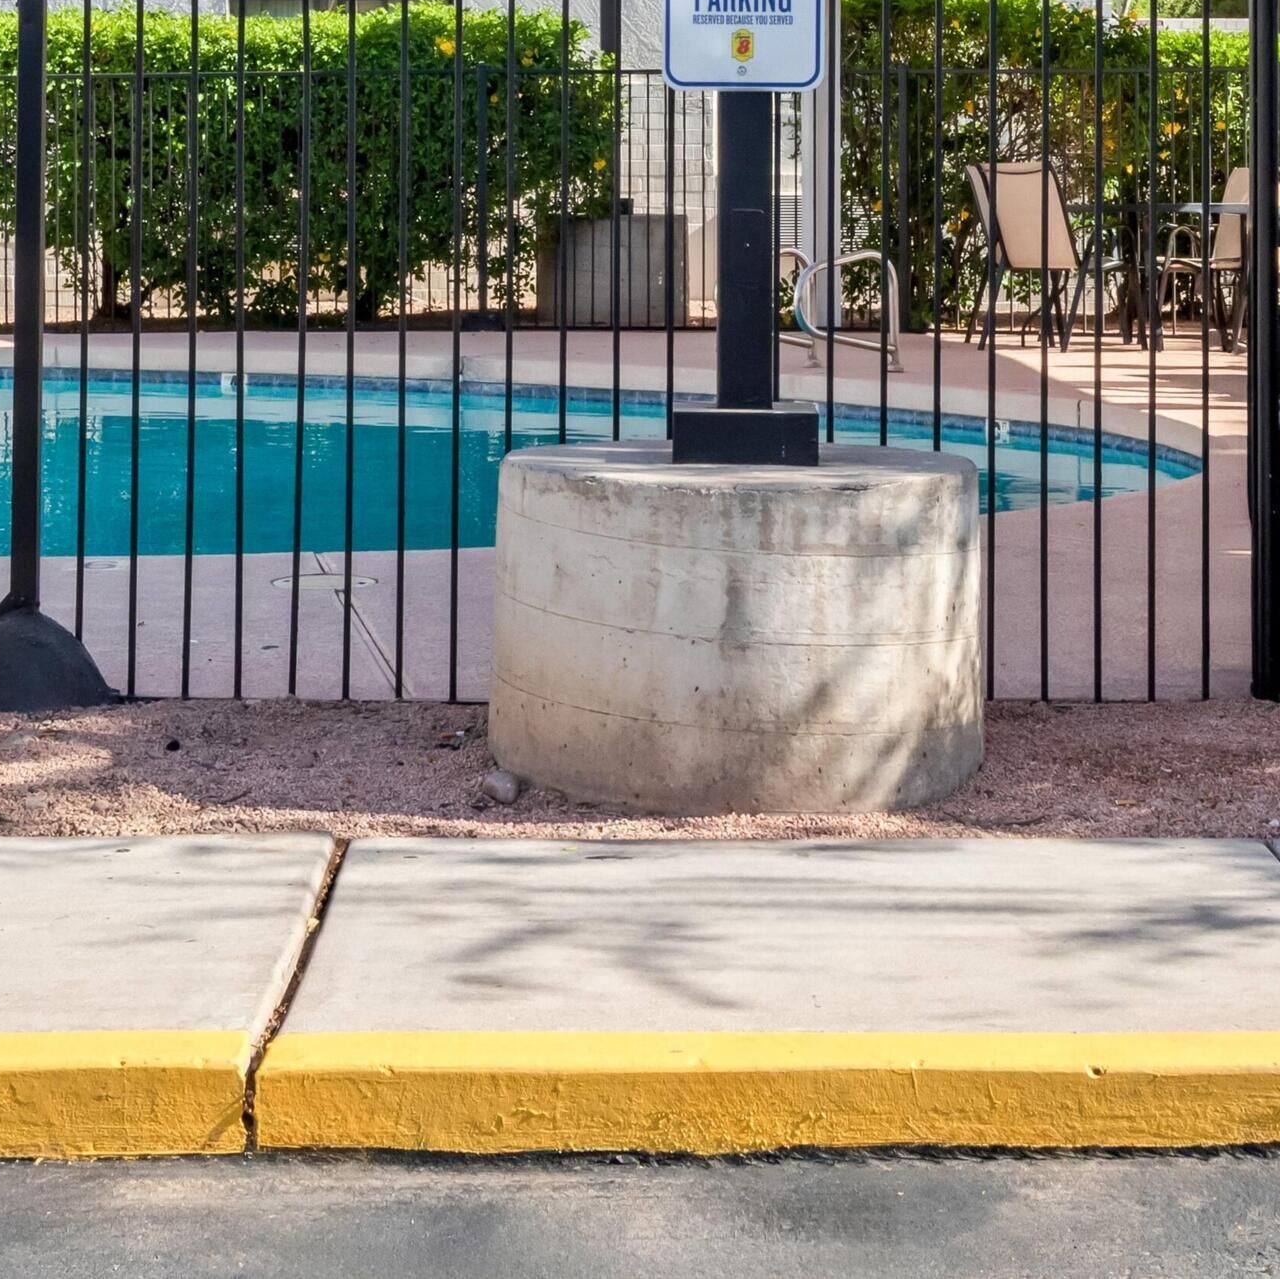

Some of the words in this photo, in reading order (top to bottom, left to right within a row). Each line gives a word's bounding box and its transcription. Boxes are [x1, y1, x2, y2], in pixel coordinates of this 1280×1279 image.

[693, 15, 724, 25] RESERVED
[726, 15, 753, 25] BECAUSE
[755, 15, 768, 25] YOU
[769, 15, 793, 25] SERVED
[736, 38, 751, 55] 8
